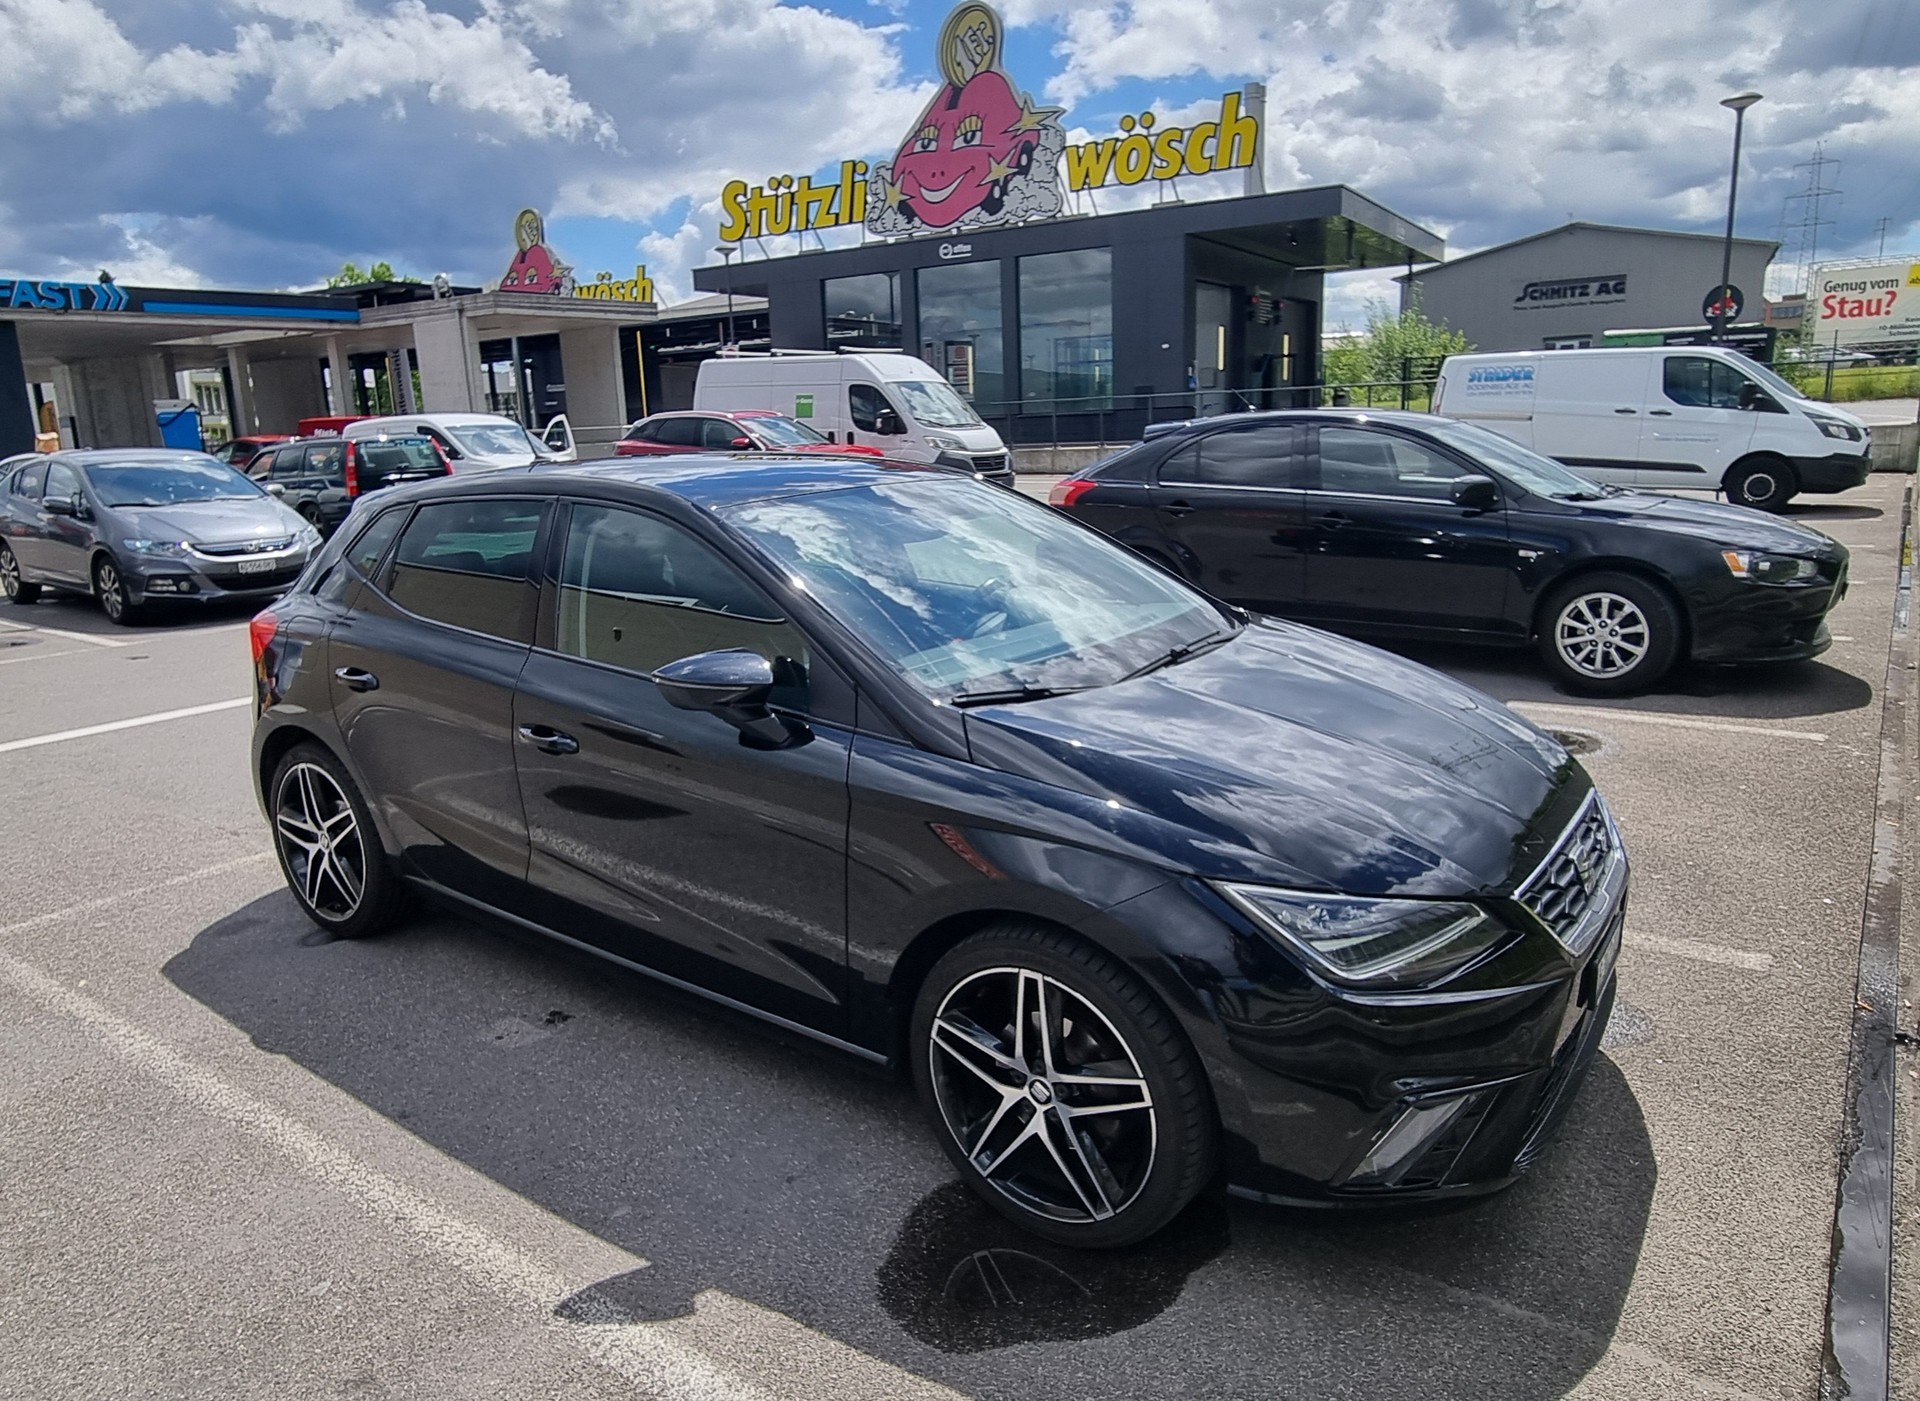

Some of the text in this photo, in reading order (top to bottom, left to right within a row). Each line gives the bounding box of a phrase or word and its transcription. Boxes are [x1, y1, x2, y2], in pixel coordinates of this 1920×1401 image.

[719, 91, 1258, 242] Stützli wösch
[575, 264, 653, 303] wösch
[1515, 281, 1626, 302] SCHMITZ AG
[1823, 278, 1899, 294] Genug vom
[1821, 290, 1897, 319] Stau?
